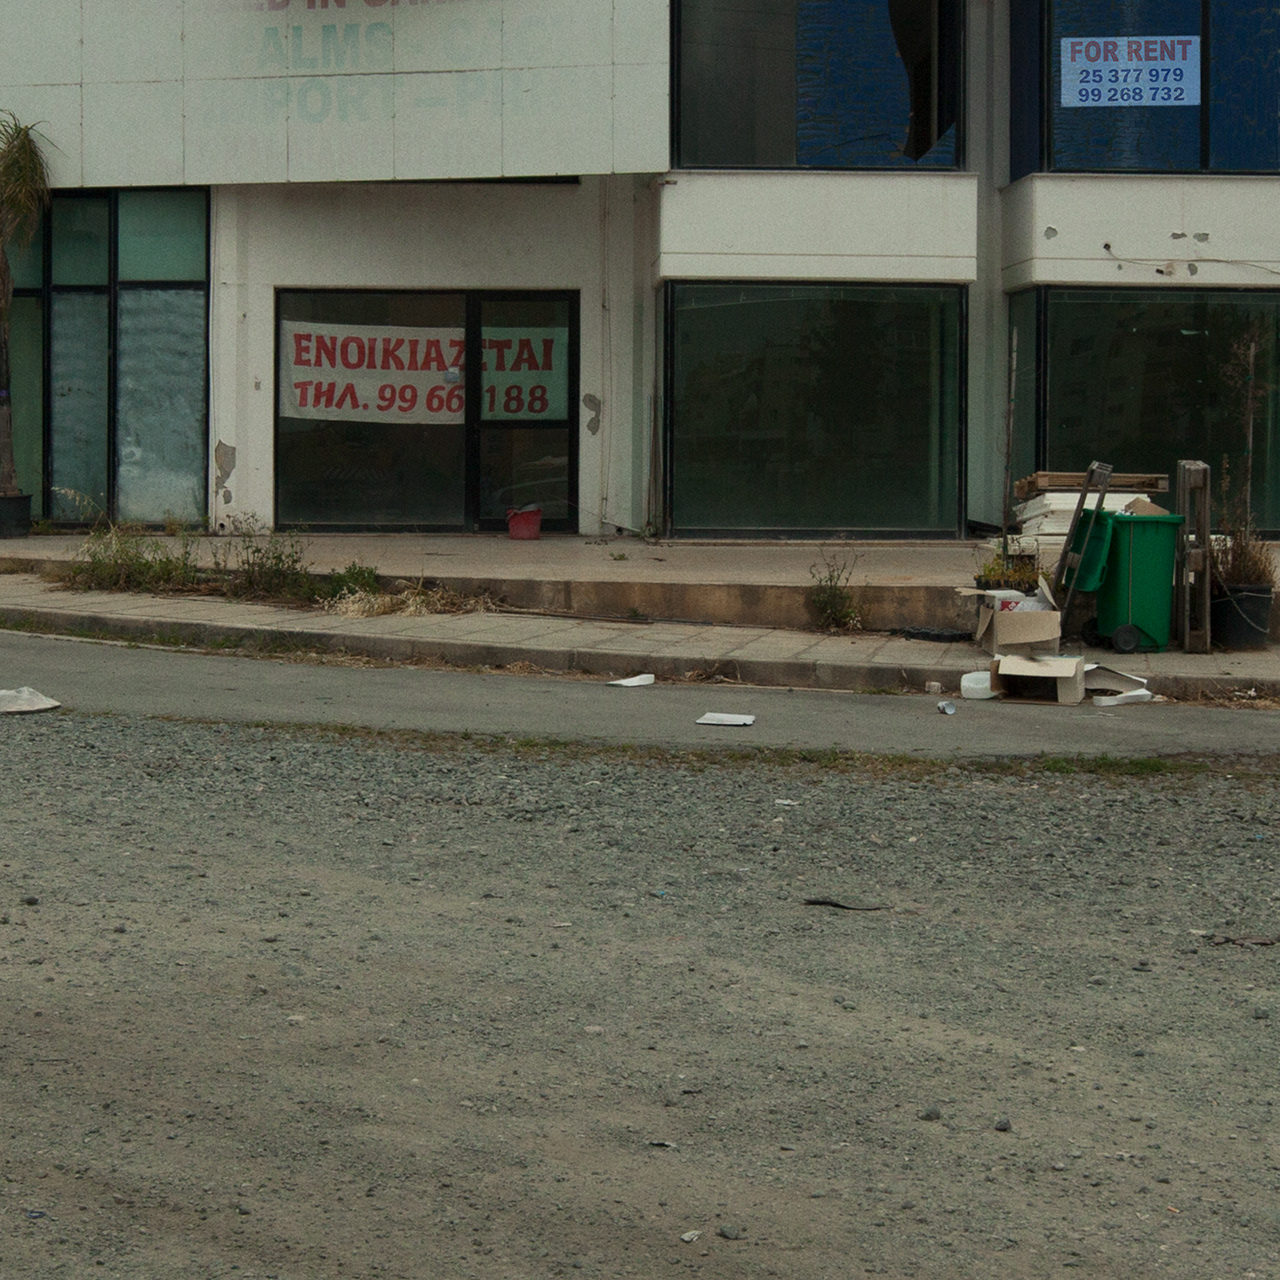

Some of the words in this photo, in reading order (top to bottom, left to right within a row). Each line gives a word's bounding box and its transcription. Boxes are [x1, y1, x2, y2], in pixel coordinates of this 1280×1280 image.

[1070, 40, 1119, 63] FOR
[1127, 39, 1193, 62] RENT
[1079, 69, 1104, 84] 25
[1108, 68, 1143, 84] 377
[1148, 67, 1184, 83] 979
[1078, 87, 1102, 102] 99
[1107, 87, 1144, 102] 268
[1149, 86, 1185, 101] 732
[293, 380, 370, 410] ΤΗΛ.
[376, 384, 418, 413] 99
